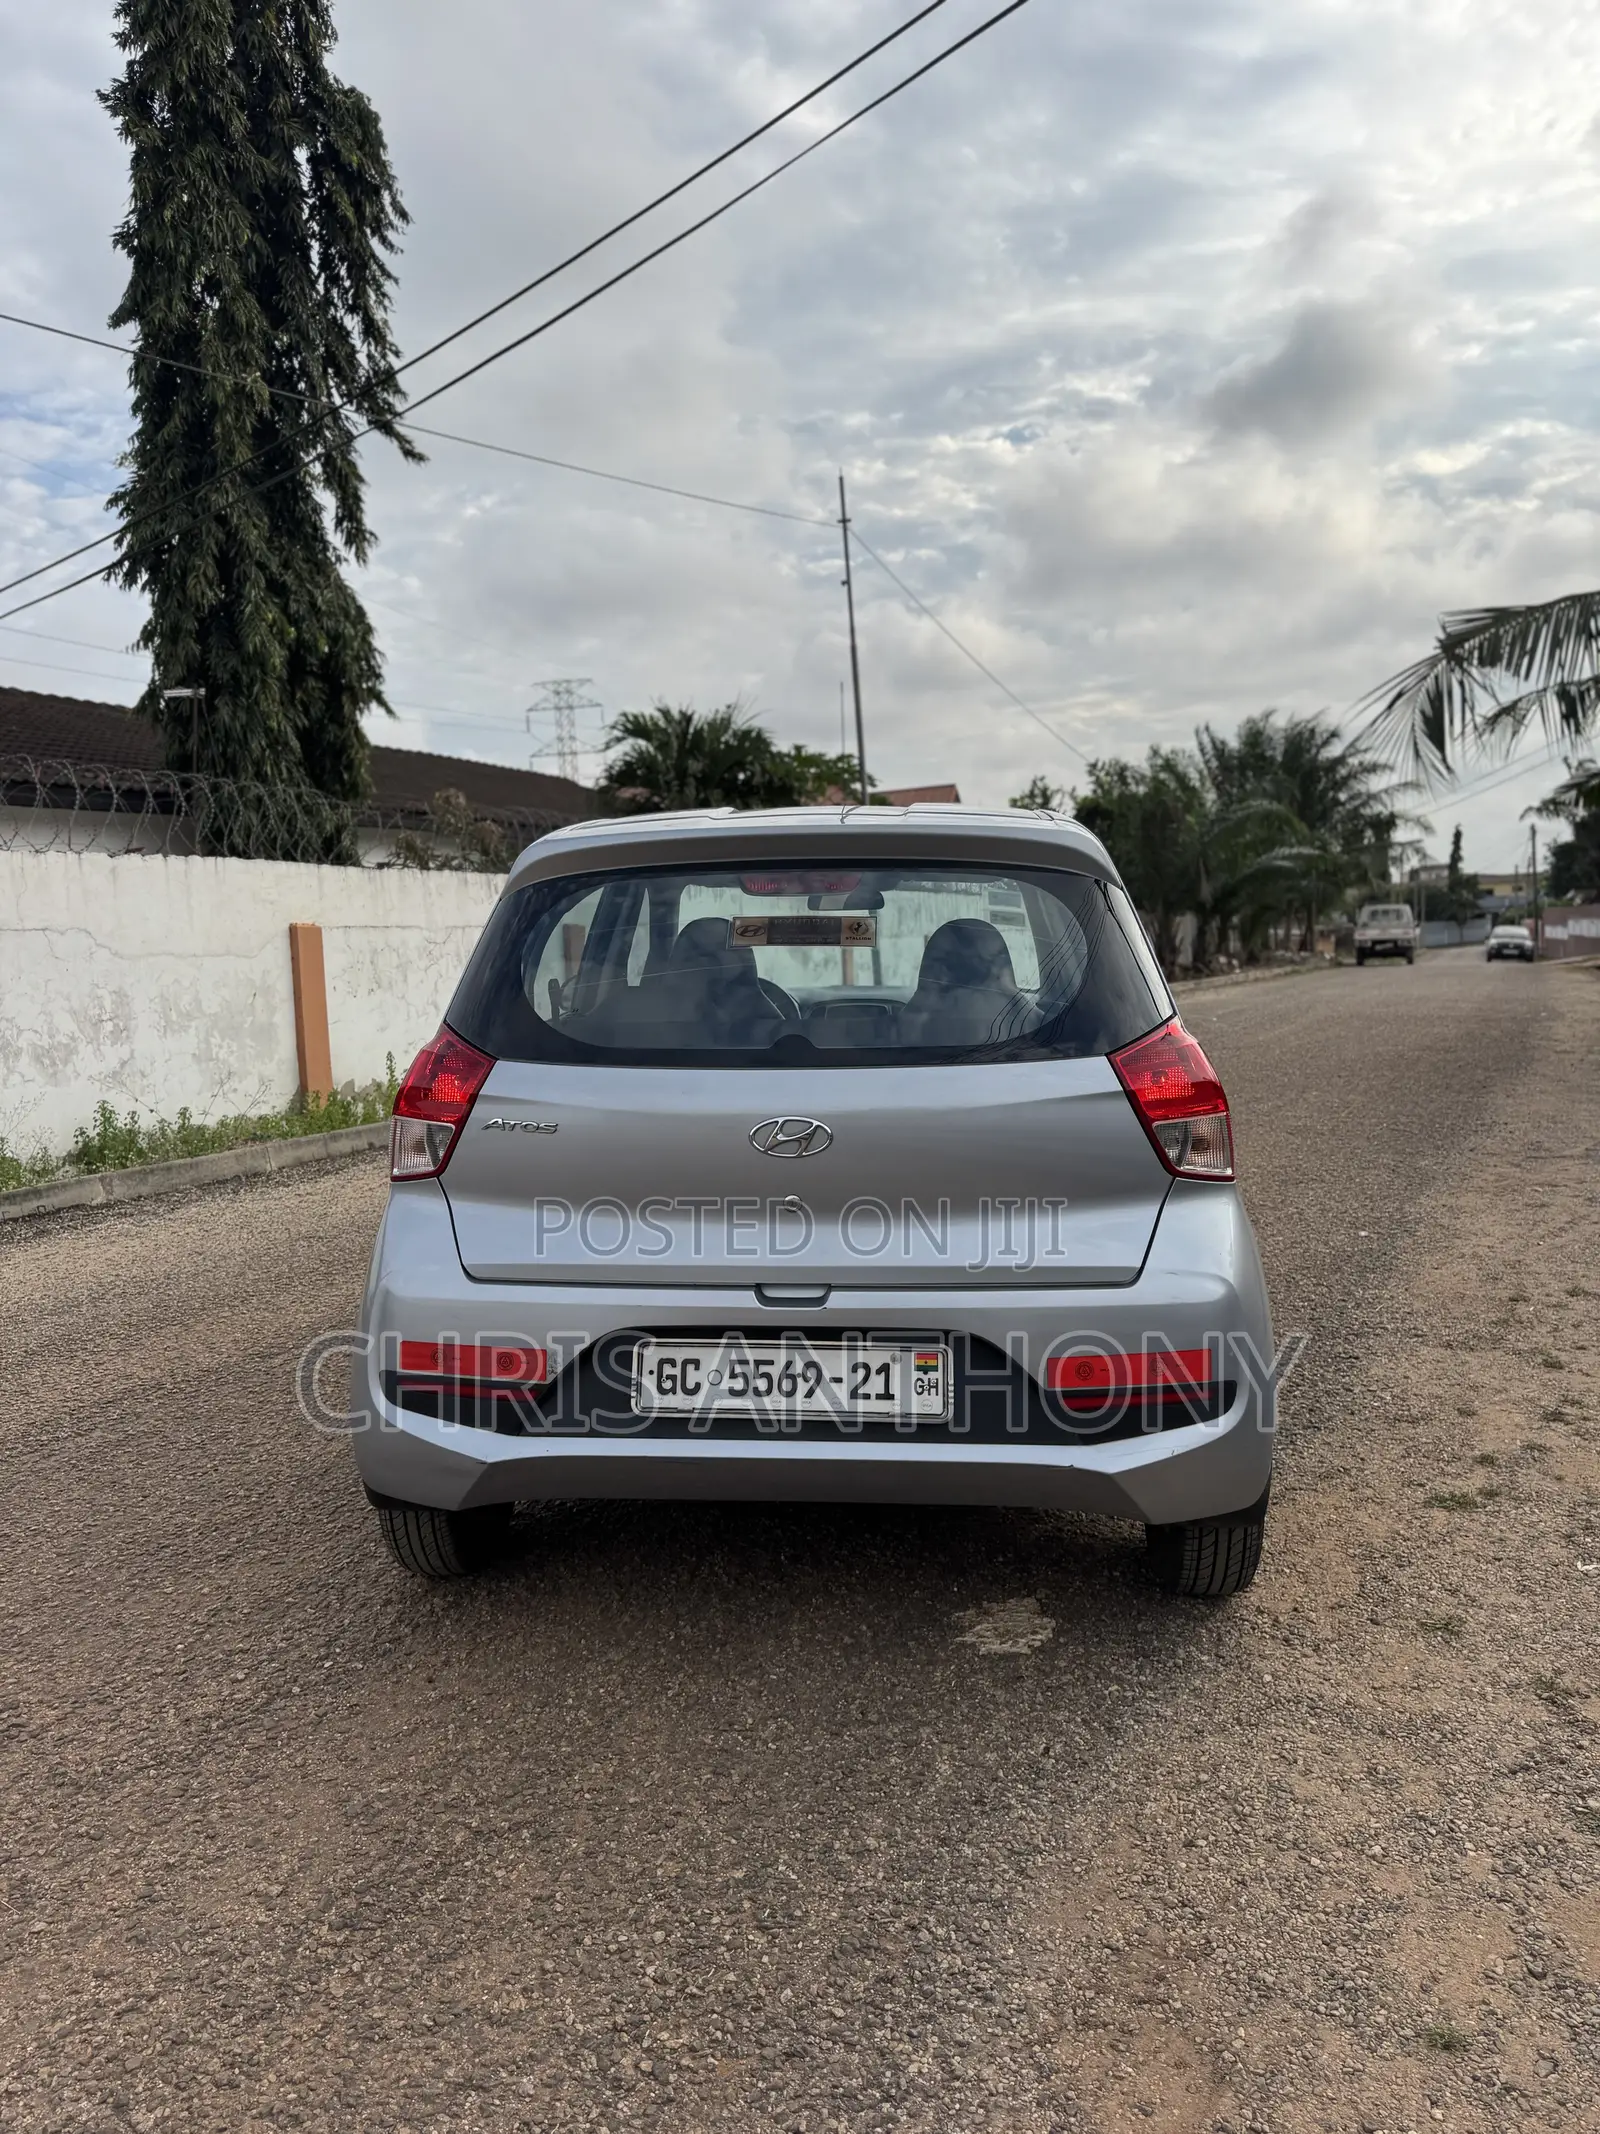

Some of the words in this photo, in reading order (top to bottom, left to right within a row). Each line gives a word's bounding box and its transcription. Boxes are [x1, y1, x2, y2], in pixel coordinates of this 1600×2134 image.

[481, 1118, 558, 1134] ATOS
[656, 1358, 701, 1397] GC
[914, 1377, 939, 1396] GH
